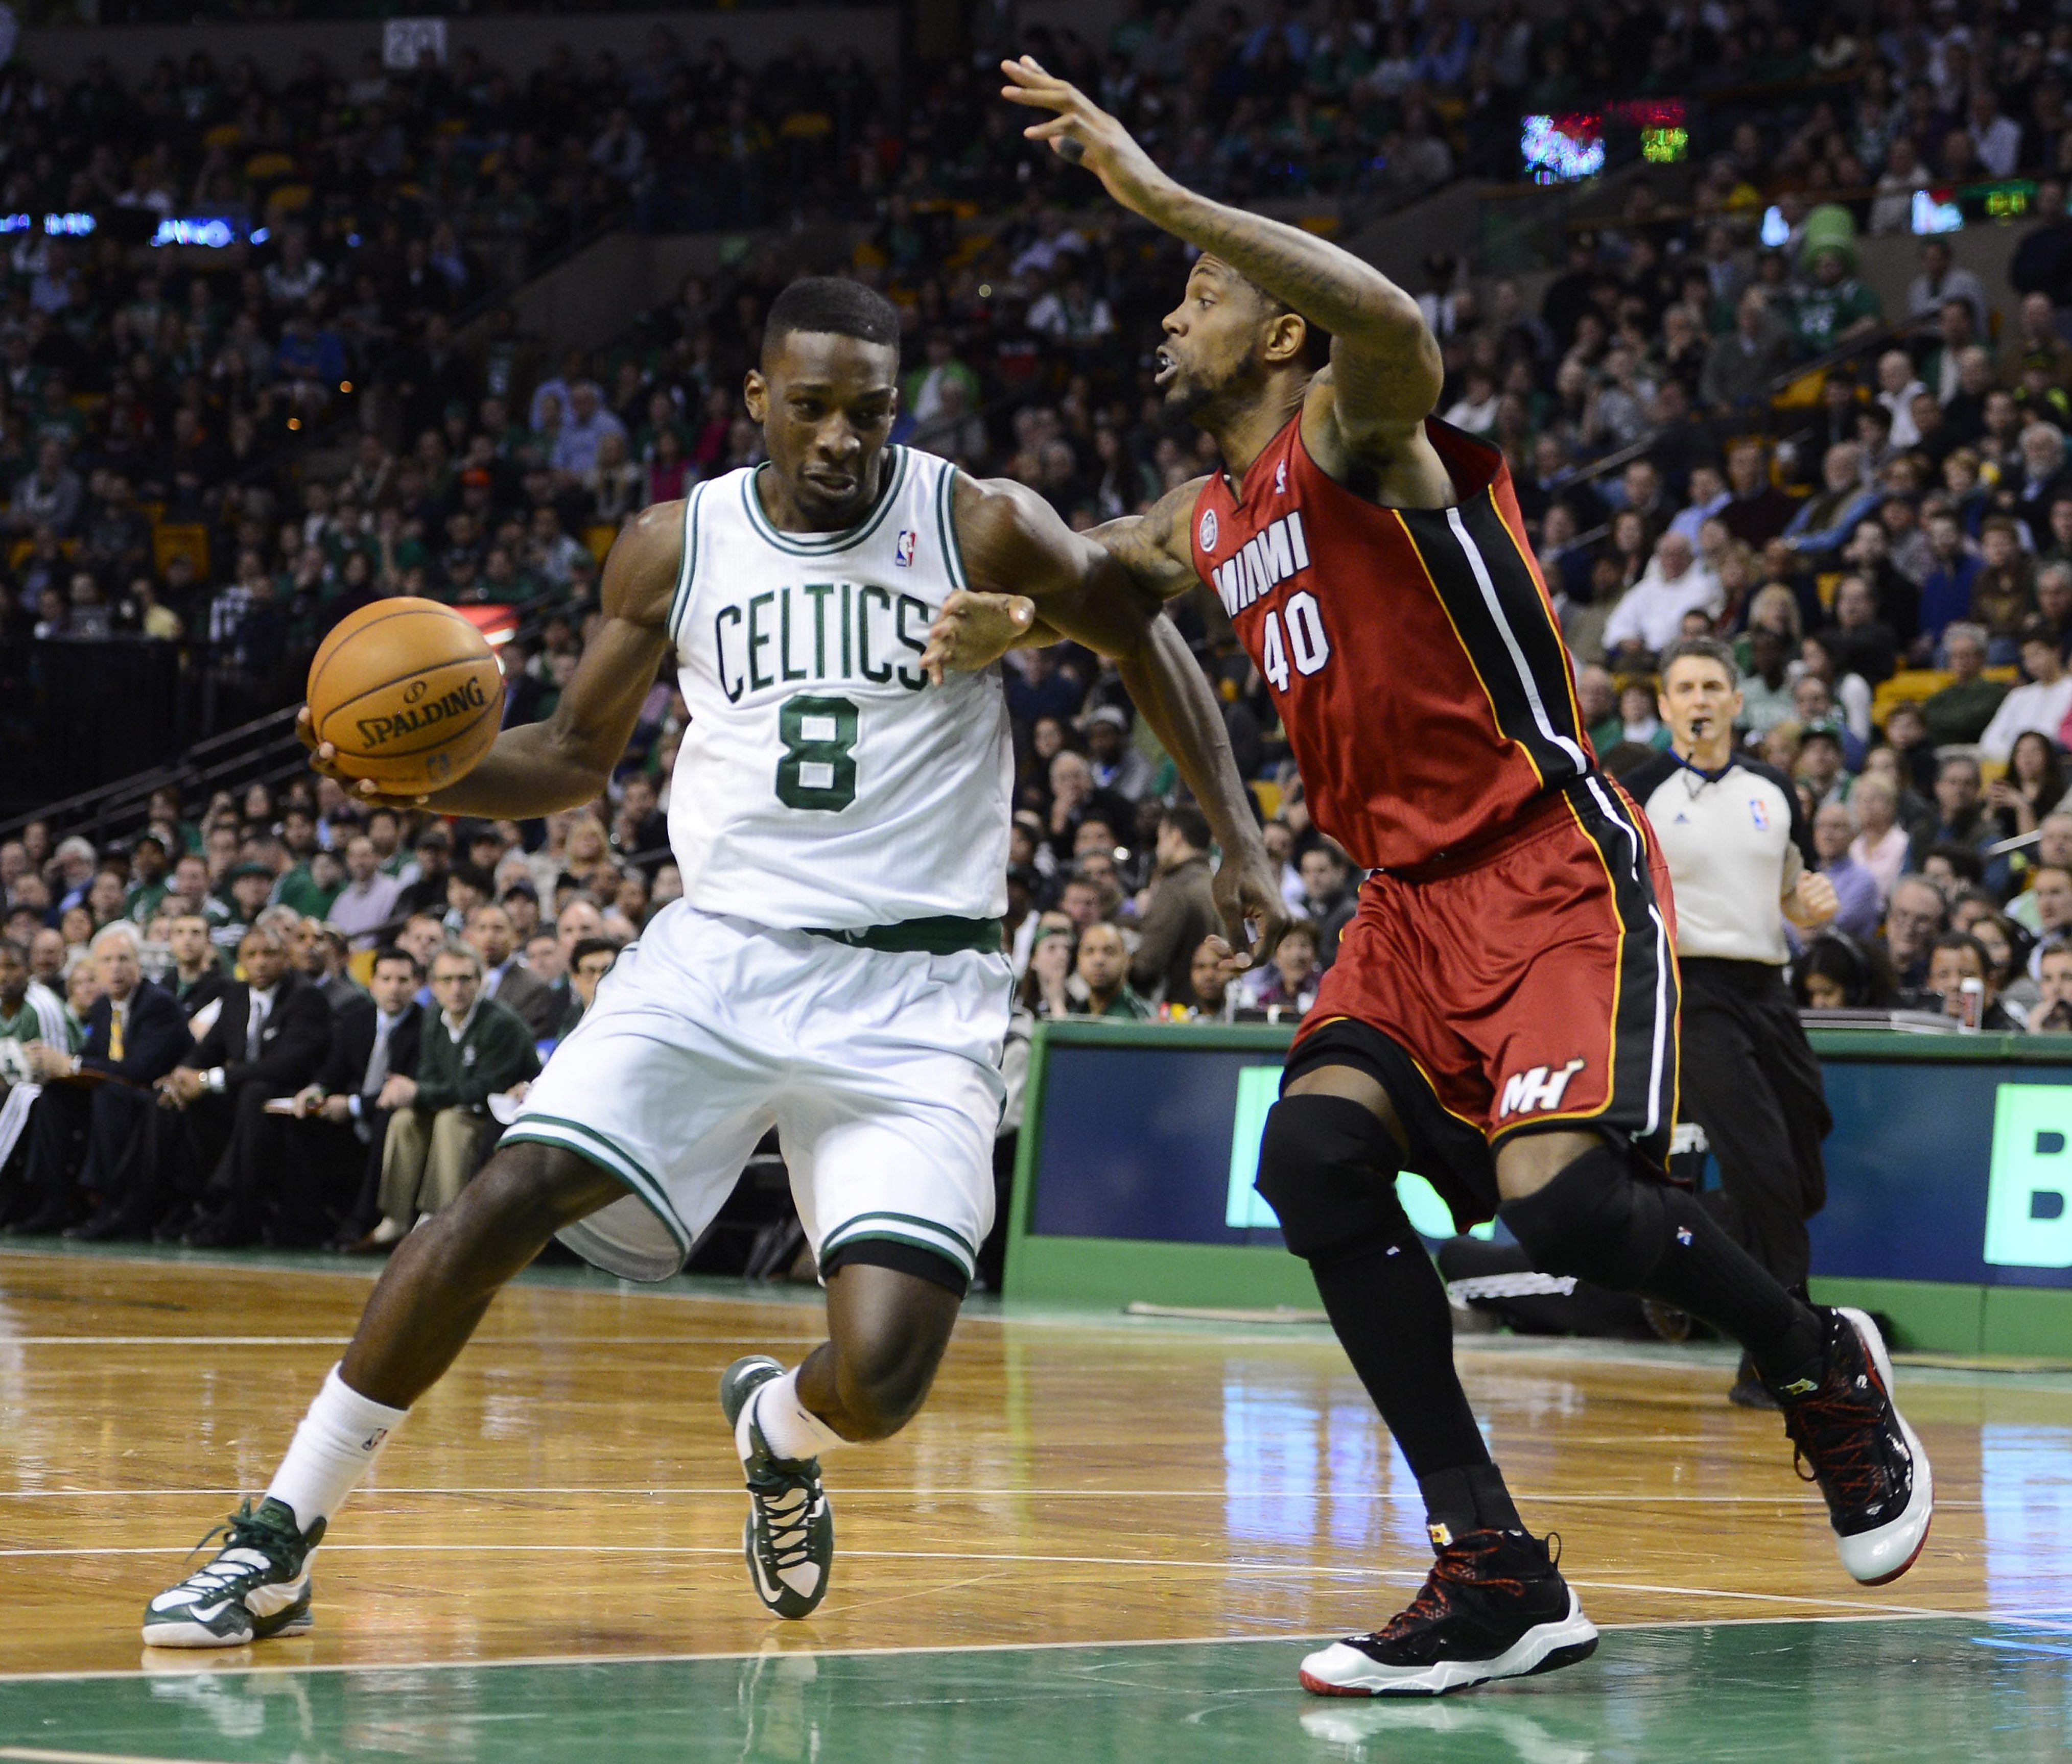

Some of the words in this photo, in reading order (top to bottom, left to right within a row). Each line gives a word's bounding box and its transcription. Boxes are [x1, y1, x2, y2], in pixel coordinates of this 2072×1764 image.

[1210, 510, 1310, 619] MIAMI
[716, 584, 929, 704] CELTICS
[1263, 590, 1330, 692] 40
[356, 675, 485, 749] SPALDING
[775, 695, 859, 812] 8
